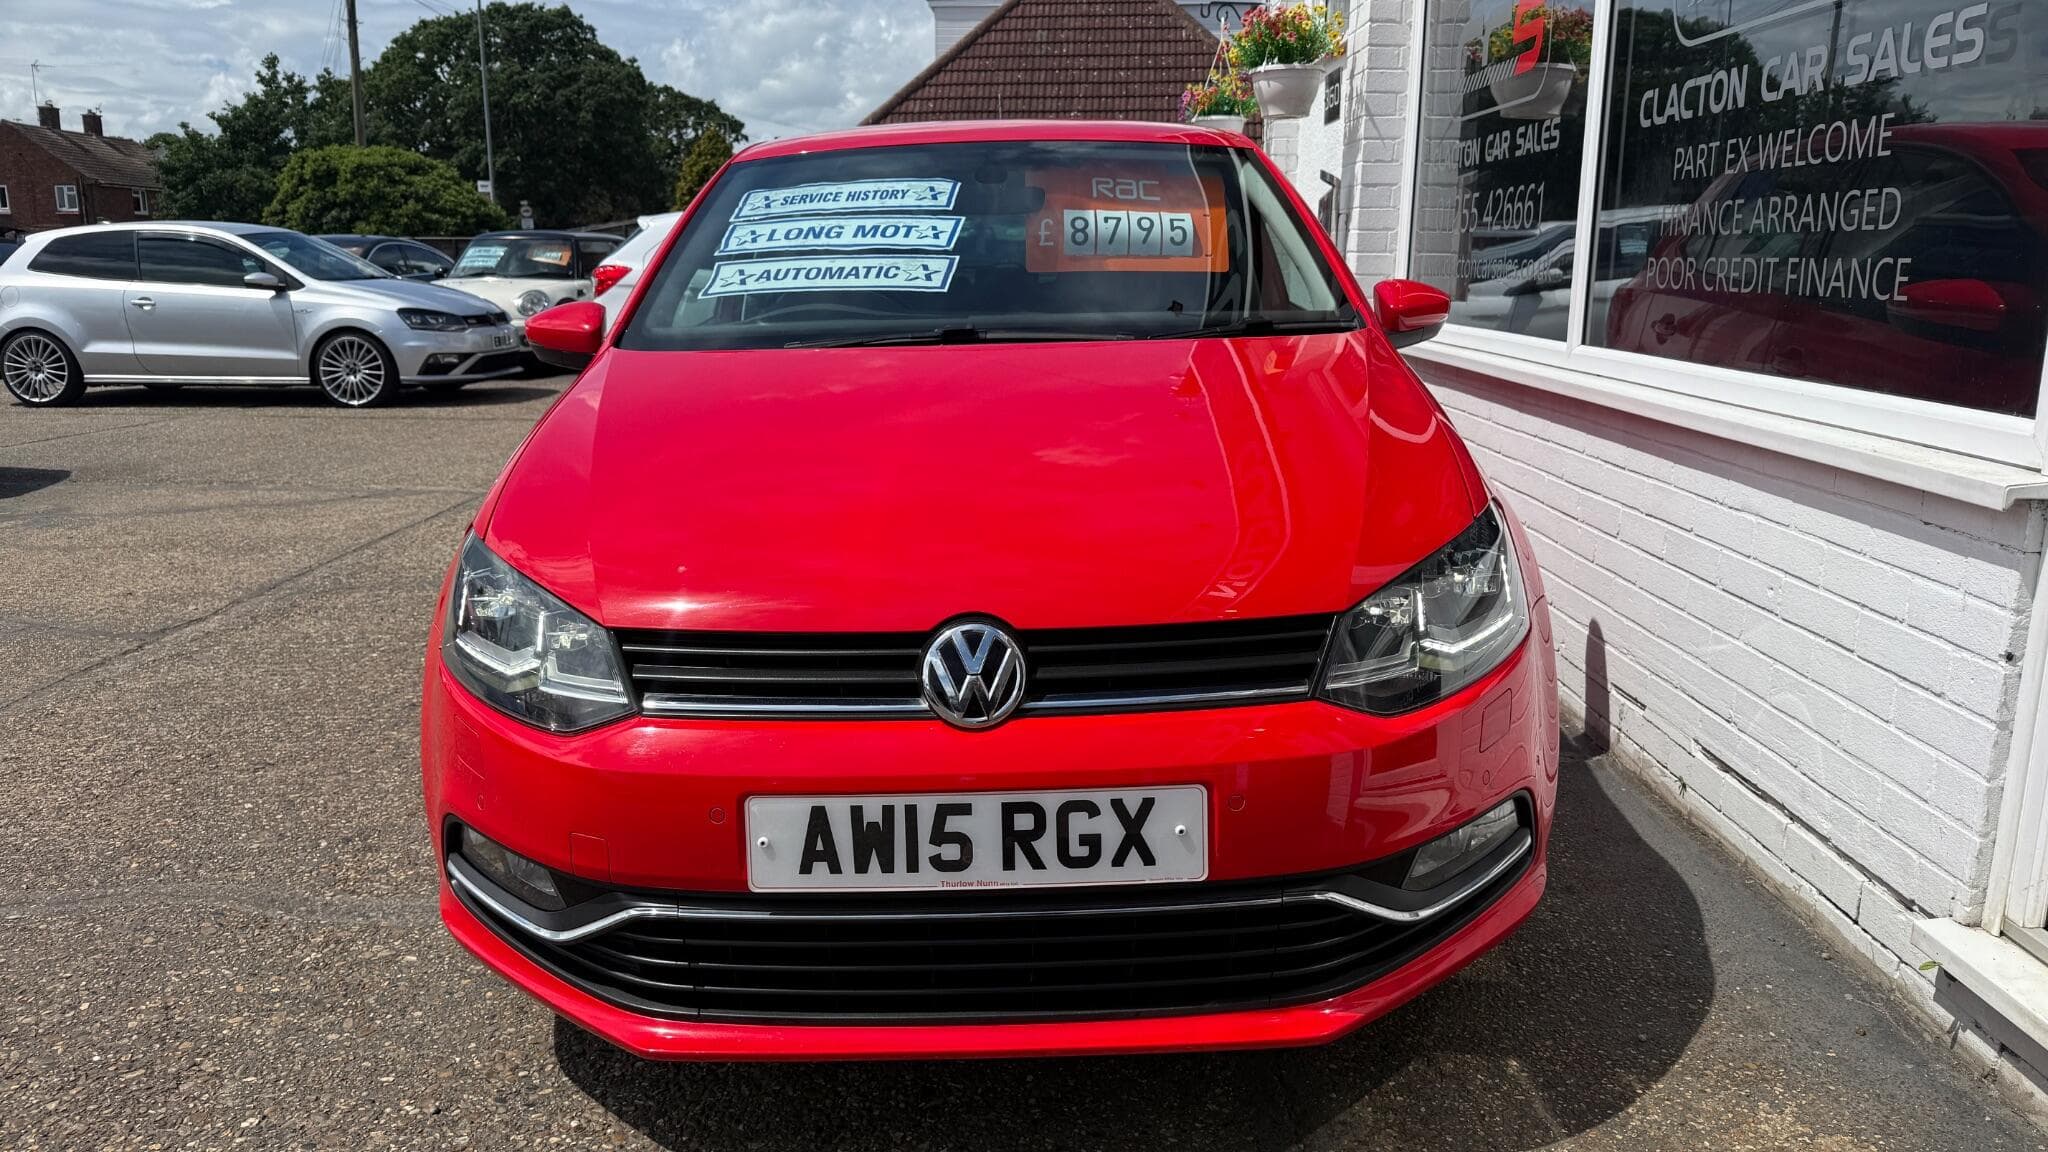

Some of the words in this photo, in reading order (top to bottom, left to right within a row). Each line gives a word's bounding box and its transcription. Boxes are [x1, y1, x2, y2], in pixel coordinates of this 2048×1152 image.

[1639, 64, 1748, 128] CLACTON
[1760, 45, 1828, 102] CAR
[1844, 2, 1988, 86] SALES
[1485, 130, 1511, 162] CAR
[1515, 117, 1561, 157] SALES
[1673, 141, 1720, 181] PART
[1724, 135, 1751, 175] EX
[1759, 112, 1895, 171] WELCOME
[780, 191, 842, 206] SERVICE
[846, 189, 910, 202] HISTORY
[1482, 181, 1545, 235] 426661
[1660, 199, 1745, 236] FINANCE
[1750, 187, 1901, 233] ARRANGED
[766, 225, 844, 242] LONG
[852, 224, 919, 239] MOT
[754, 265, 901, 283] AUTOMATIC
[1646, 257, 1696, 290] POOR
[1702, 257, 1780, 294] CREDIT
[1785, 257, 1912, 301] FINANCE
[799, 802, 974, 875] AW15
[1000, 797, 1156, 872] RGX
[941, 880, 974, 888] Thurlow
[976, 879, 998, 887] Nunn
